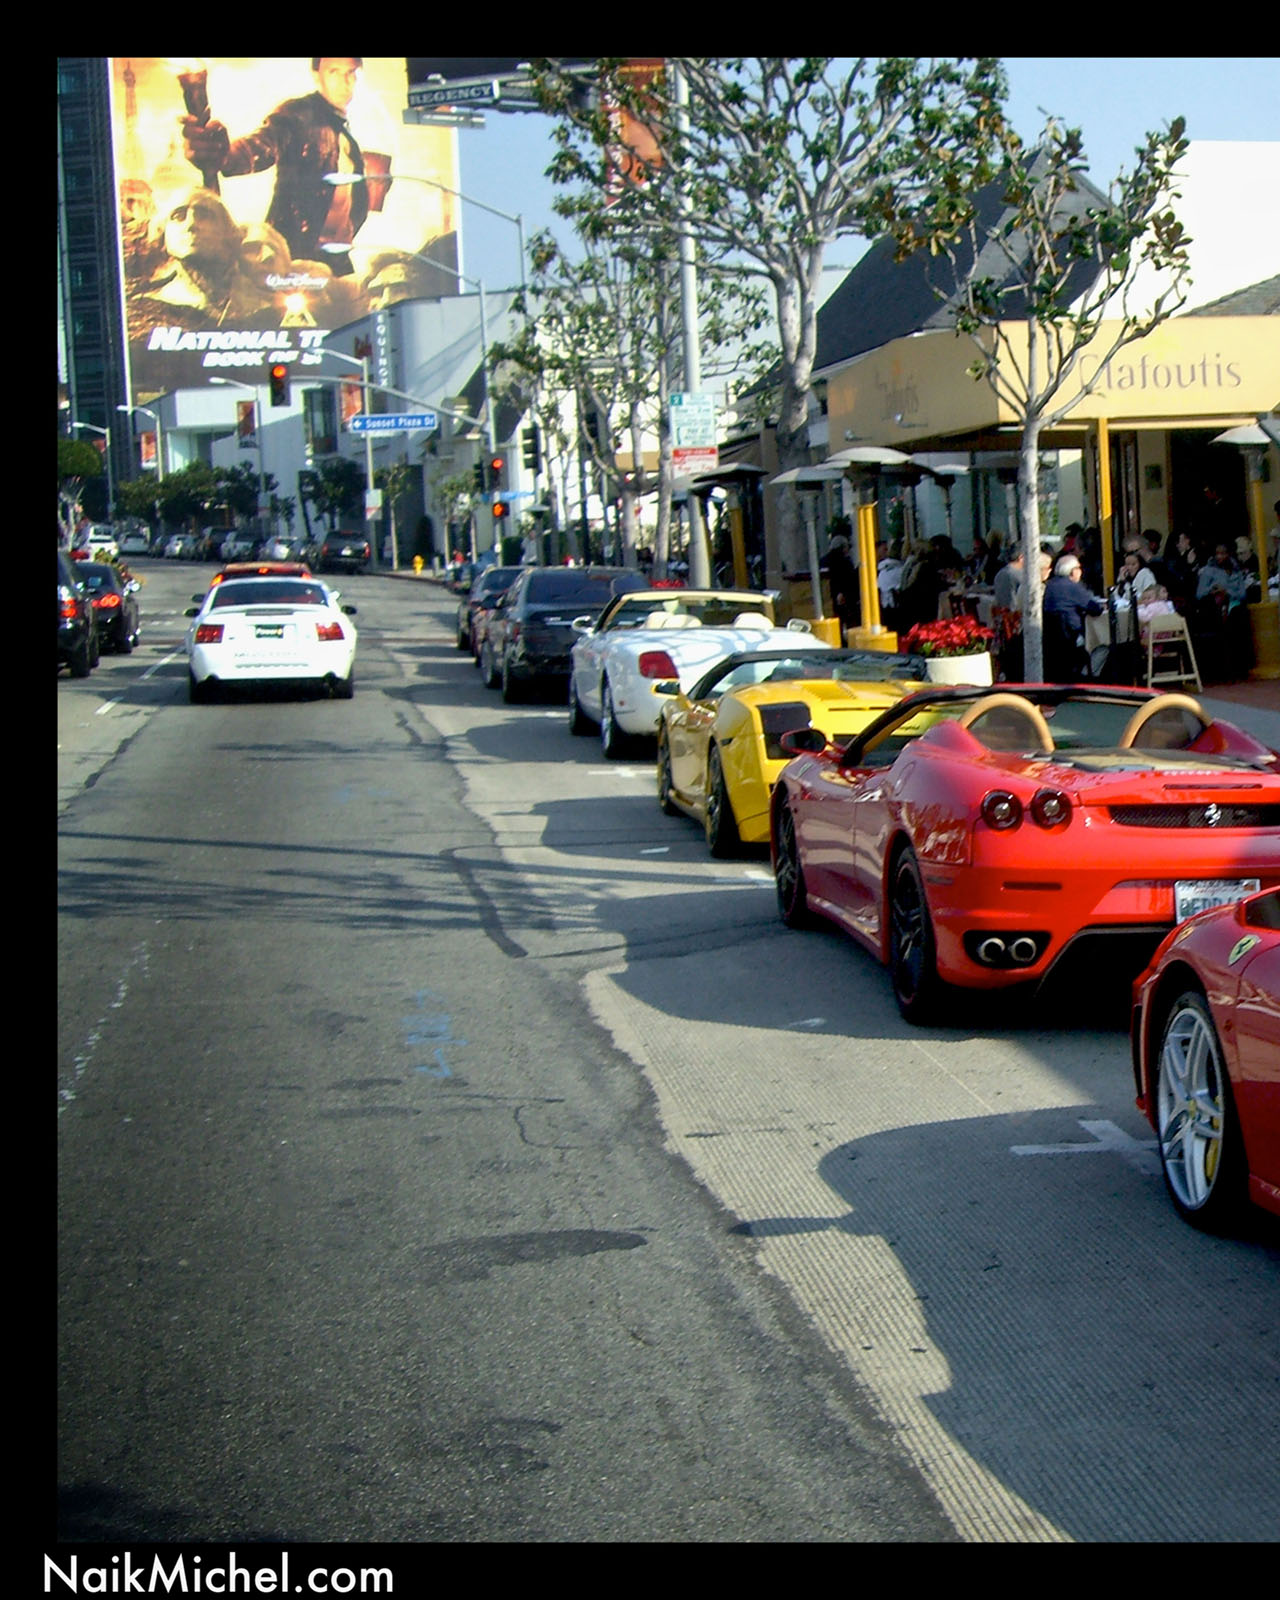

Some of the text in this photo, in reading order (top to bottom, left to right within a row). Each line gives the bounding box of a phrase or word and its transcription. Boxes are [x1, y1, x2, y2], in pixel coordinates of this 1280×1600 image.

[409, 85, 491, 105] REGENCY
[203, 352, 265, 367] BOOK
[376, 313, 389, 387] EQUINOX
[1078, 351, 1243, 393] Clafoutis
[366, 416, 434, 429] Sunset Plaza Dr
